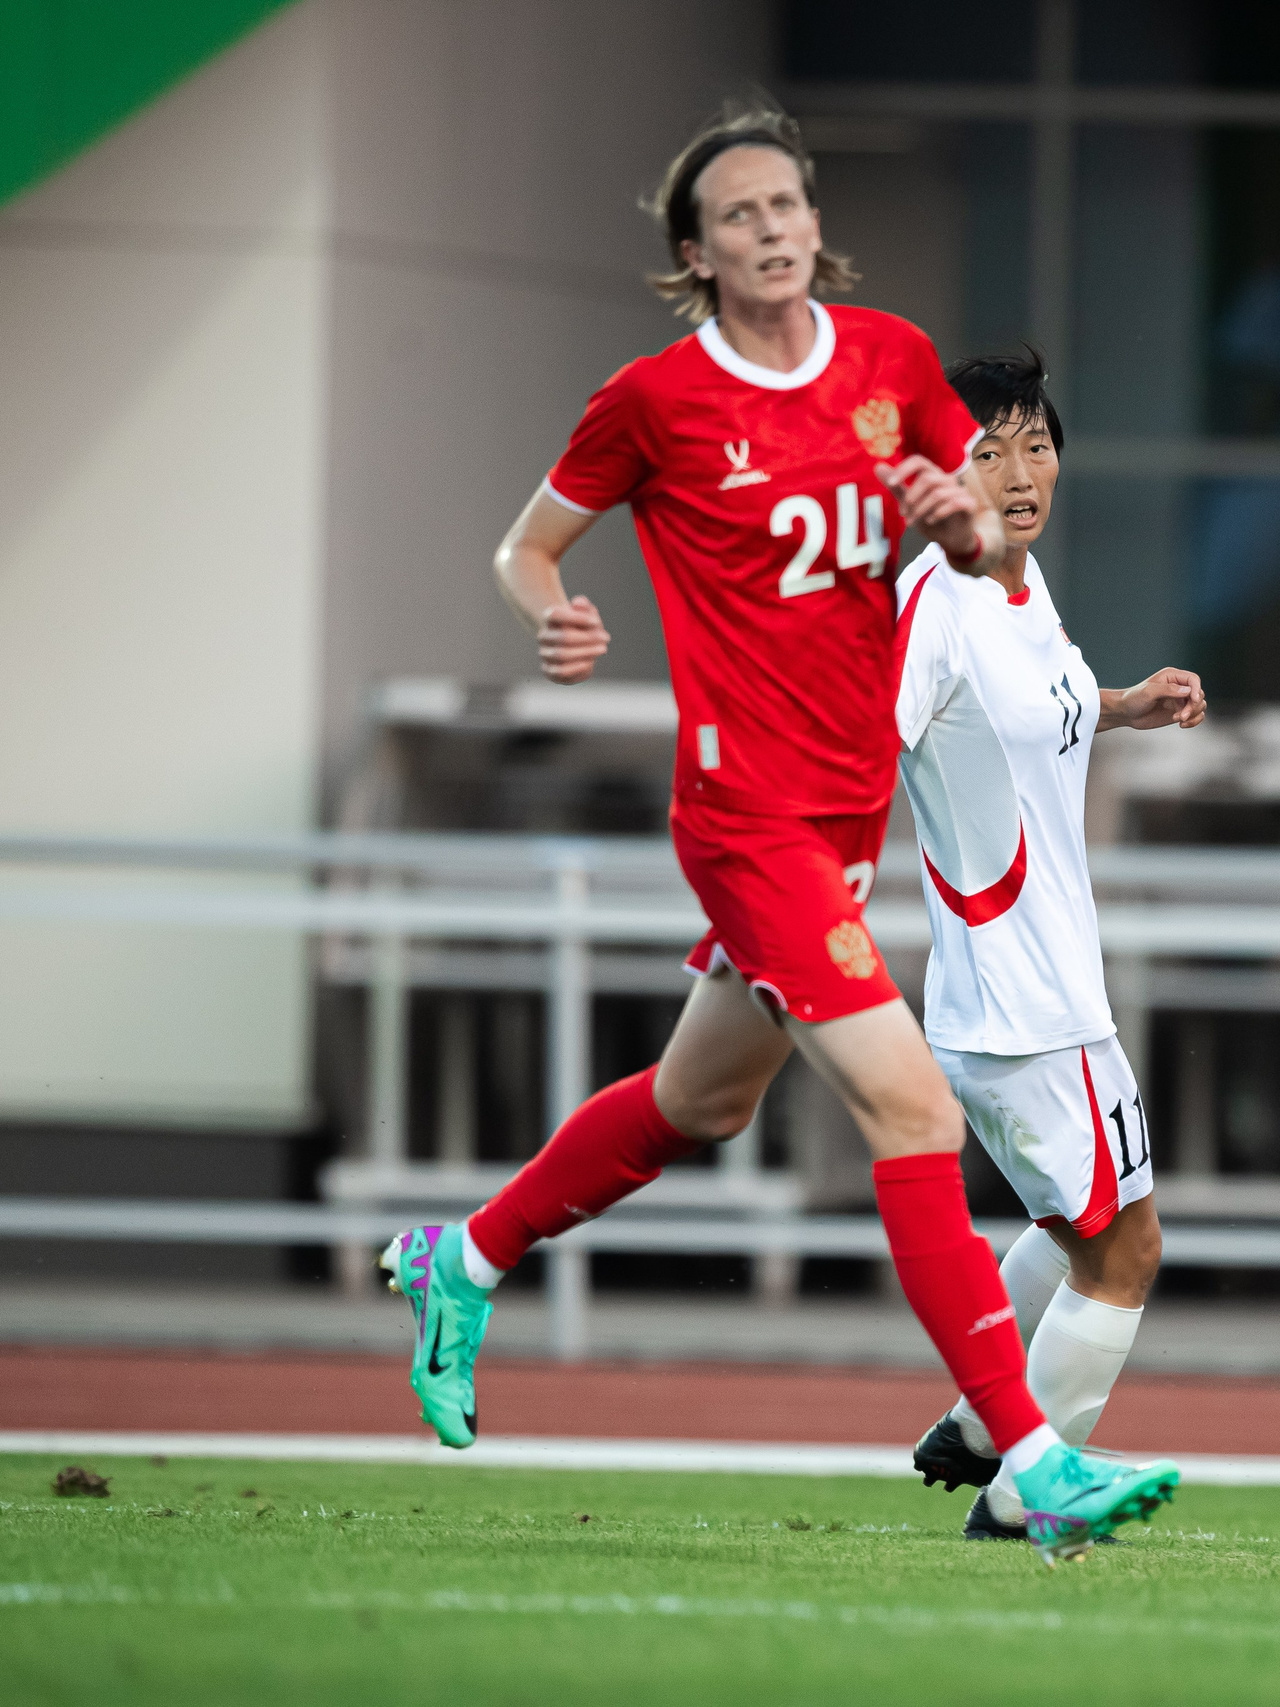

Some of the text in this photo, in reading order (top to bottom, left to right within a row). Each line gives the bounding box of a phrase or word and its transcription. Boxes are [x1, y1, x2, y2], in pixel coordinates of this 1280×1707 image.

[769, 482, 891, 599] 24
[1050, 672, 1082, 756] 11
[1109, 1090, 1149, 1181] 11
